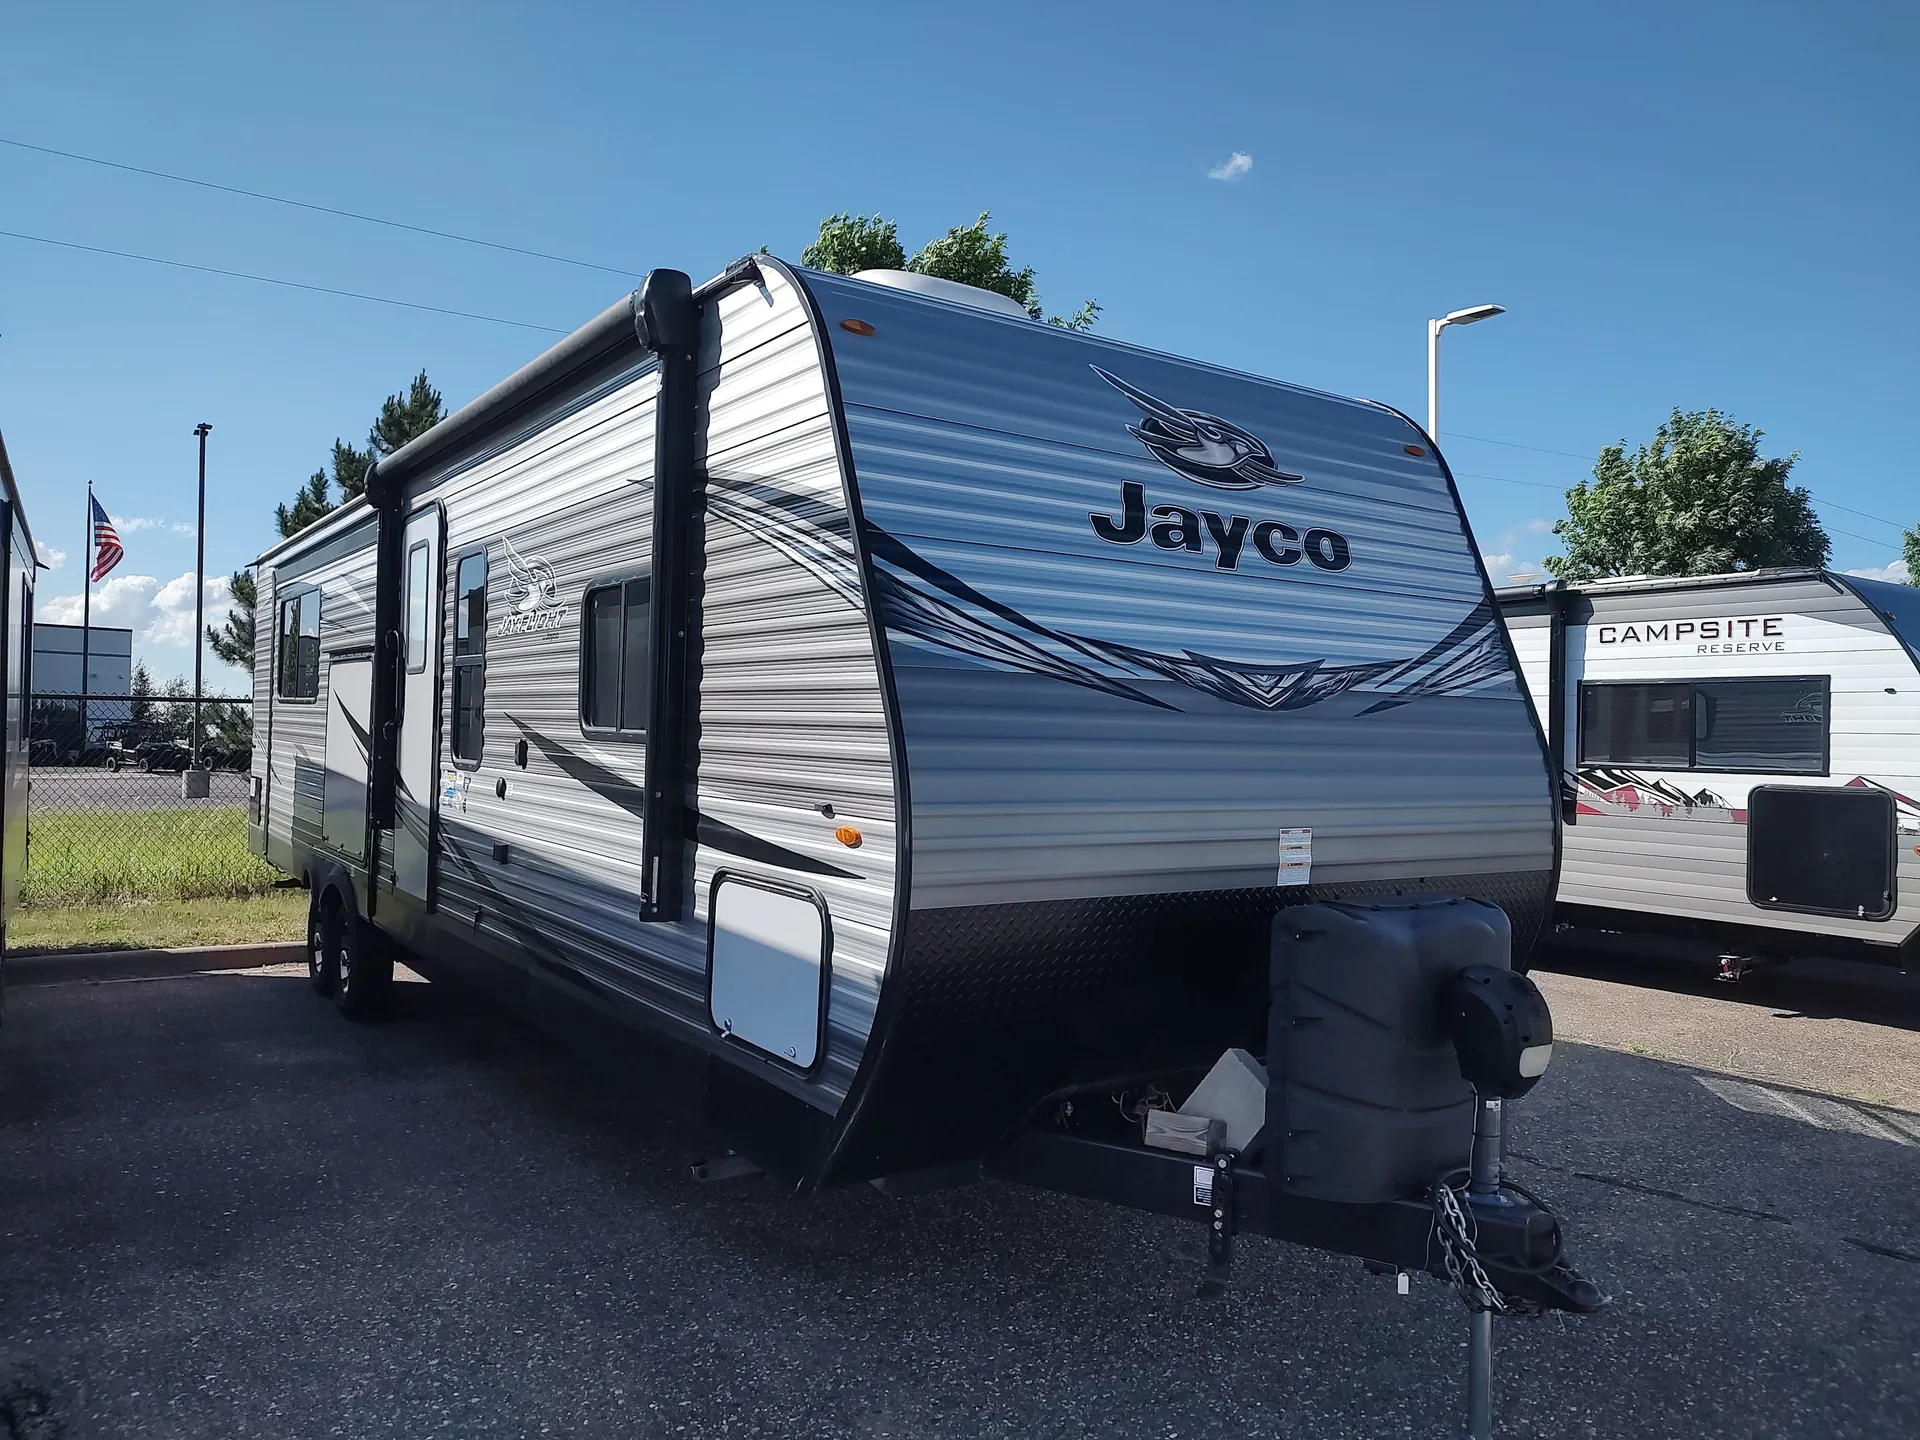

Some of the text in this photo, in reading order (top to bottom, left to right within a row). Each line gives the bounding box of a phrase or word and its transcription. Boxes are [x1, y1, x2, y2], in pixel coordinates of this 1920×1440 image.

[1088, 479, 1353, 573] Jayco
[1599, 617, 1784, 644] CAMPSITE
[1697, 641, 1786, 654] RESERVE
